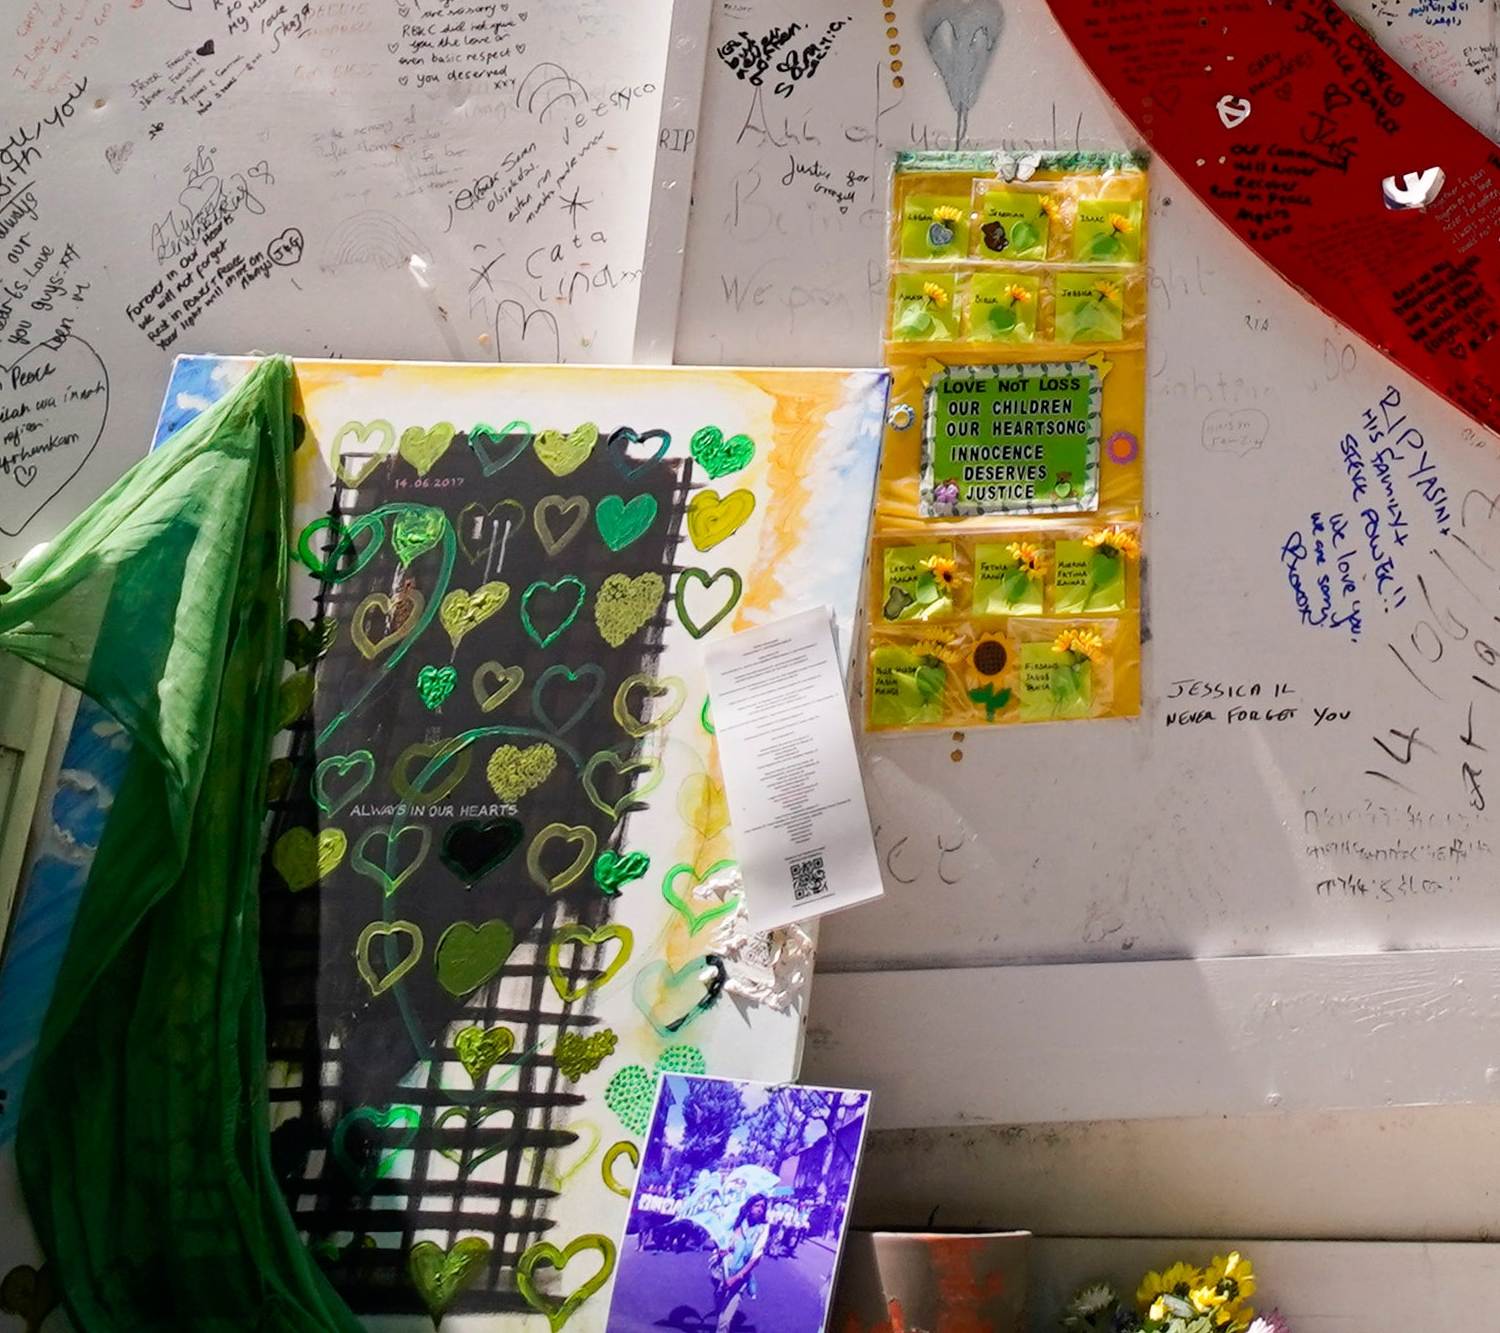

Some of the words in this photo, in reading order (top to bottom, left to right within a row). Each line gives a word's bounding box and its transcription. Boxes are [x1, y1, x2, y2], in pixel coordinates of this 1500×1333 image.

[943, 381, 986, 394] LOVE
[1039, 378, 1080, 391] LOSS
[949, 402, 980, 415] OUR
[993, 399, 1072, 415] CHILDREN
[947, 422, 979, 436] OUR
[993, 421, 1086, 435] HEARTSONG
[952, 446, 1044, 461] INNOCENCE
[964, 466, 1047, 481] DESERVES
[395, 478, 465, 488] 14.06.2017
[967, 485, 1034, 501] JUSTICE
[350, 804, 406, 816] ALWAYS
[411, 805, 425, 816] IN
[429, 806, 454, 816] OUR
[460, 804, 519, 816] HEARTS
